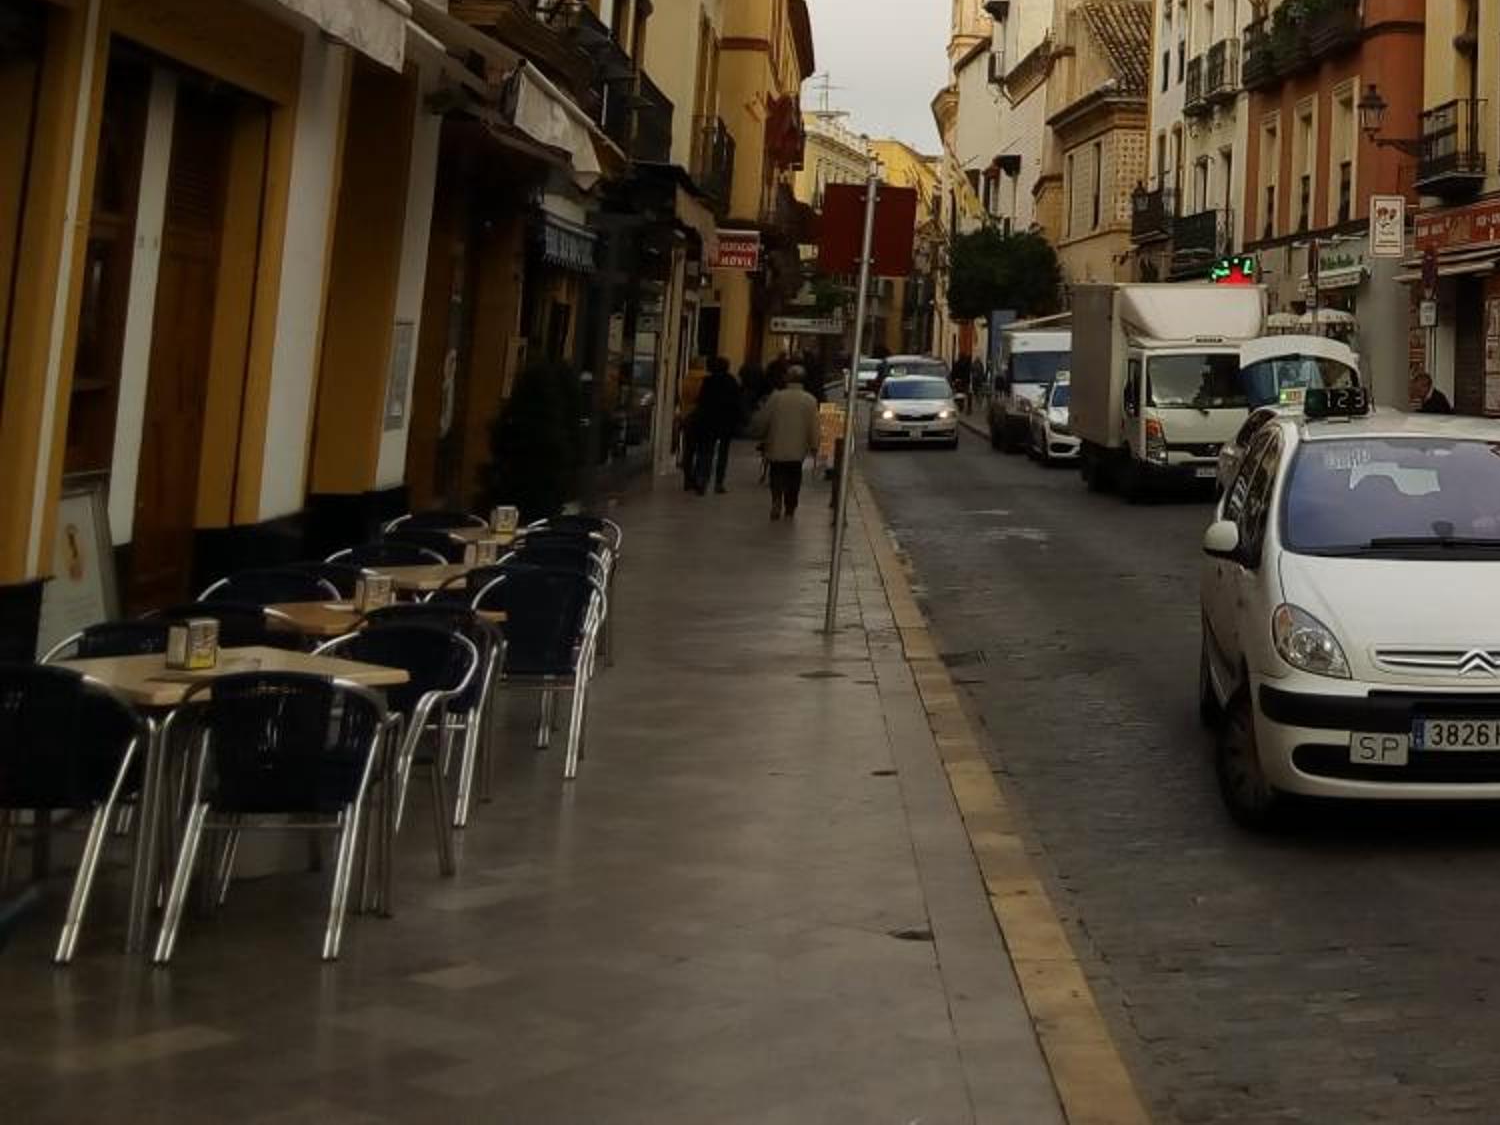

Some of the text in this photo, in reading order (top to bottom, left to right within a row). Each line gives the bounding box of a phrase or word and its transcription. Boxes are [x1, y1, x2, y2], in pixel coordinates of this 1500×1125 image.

[1326, 387, 1366, 409] 123
[1430, 724, 1490, 746] 3826
[1358, 735, 1400, 761] SP
